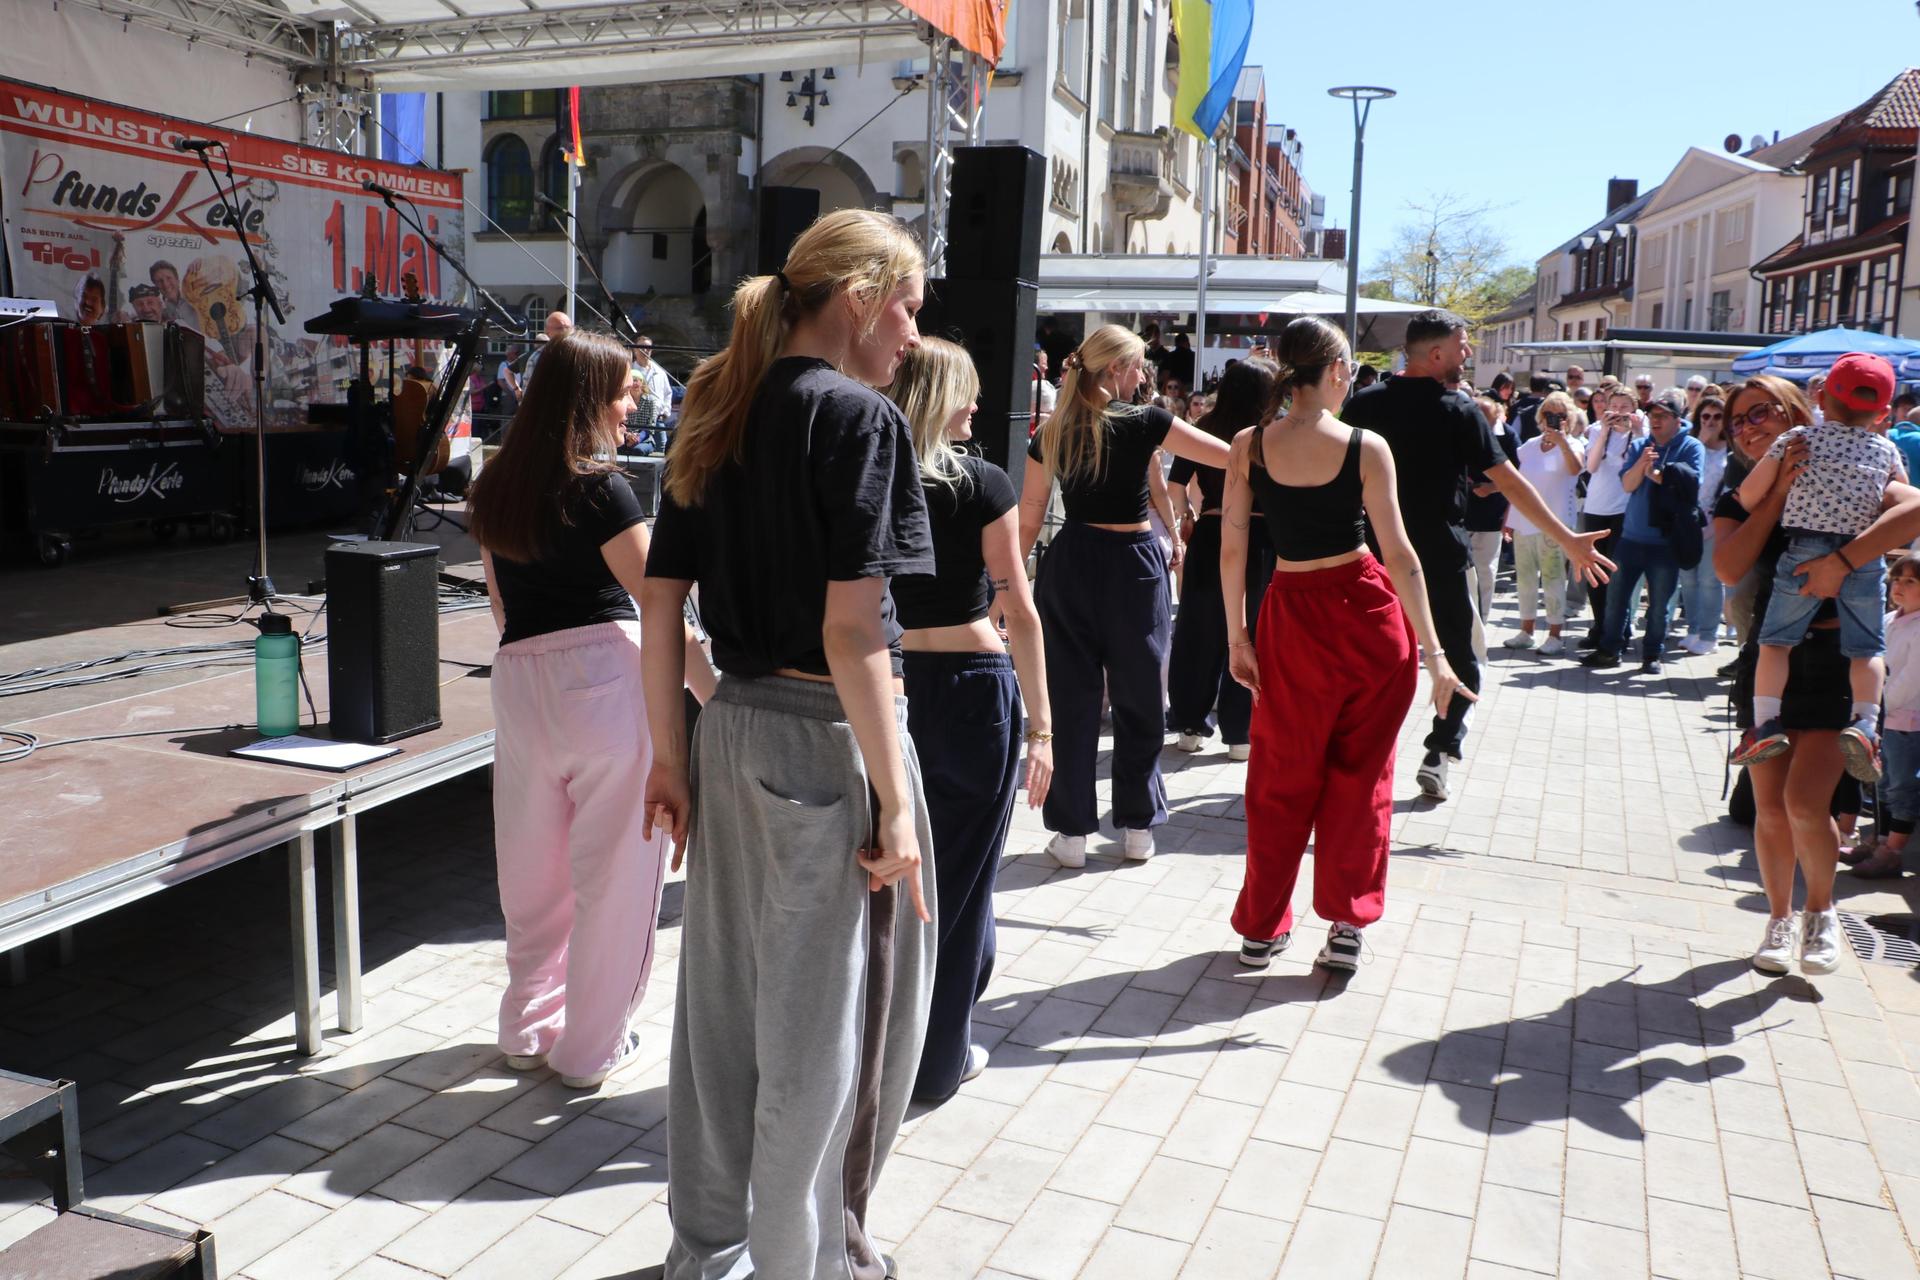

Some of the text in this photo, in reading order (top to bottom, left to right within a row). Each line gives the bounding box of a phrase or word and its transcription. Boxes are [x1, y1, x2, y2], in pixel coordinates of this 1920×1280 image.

[336, 164, 450, 196] KOMMEN
[20, 226, 37, 236] DAS
[39, 229, 66, 239] BESTE
[147, 233, 202, 249] spezial
[23, 241, 101, 272] Tirol
